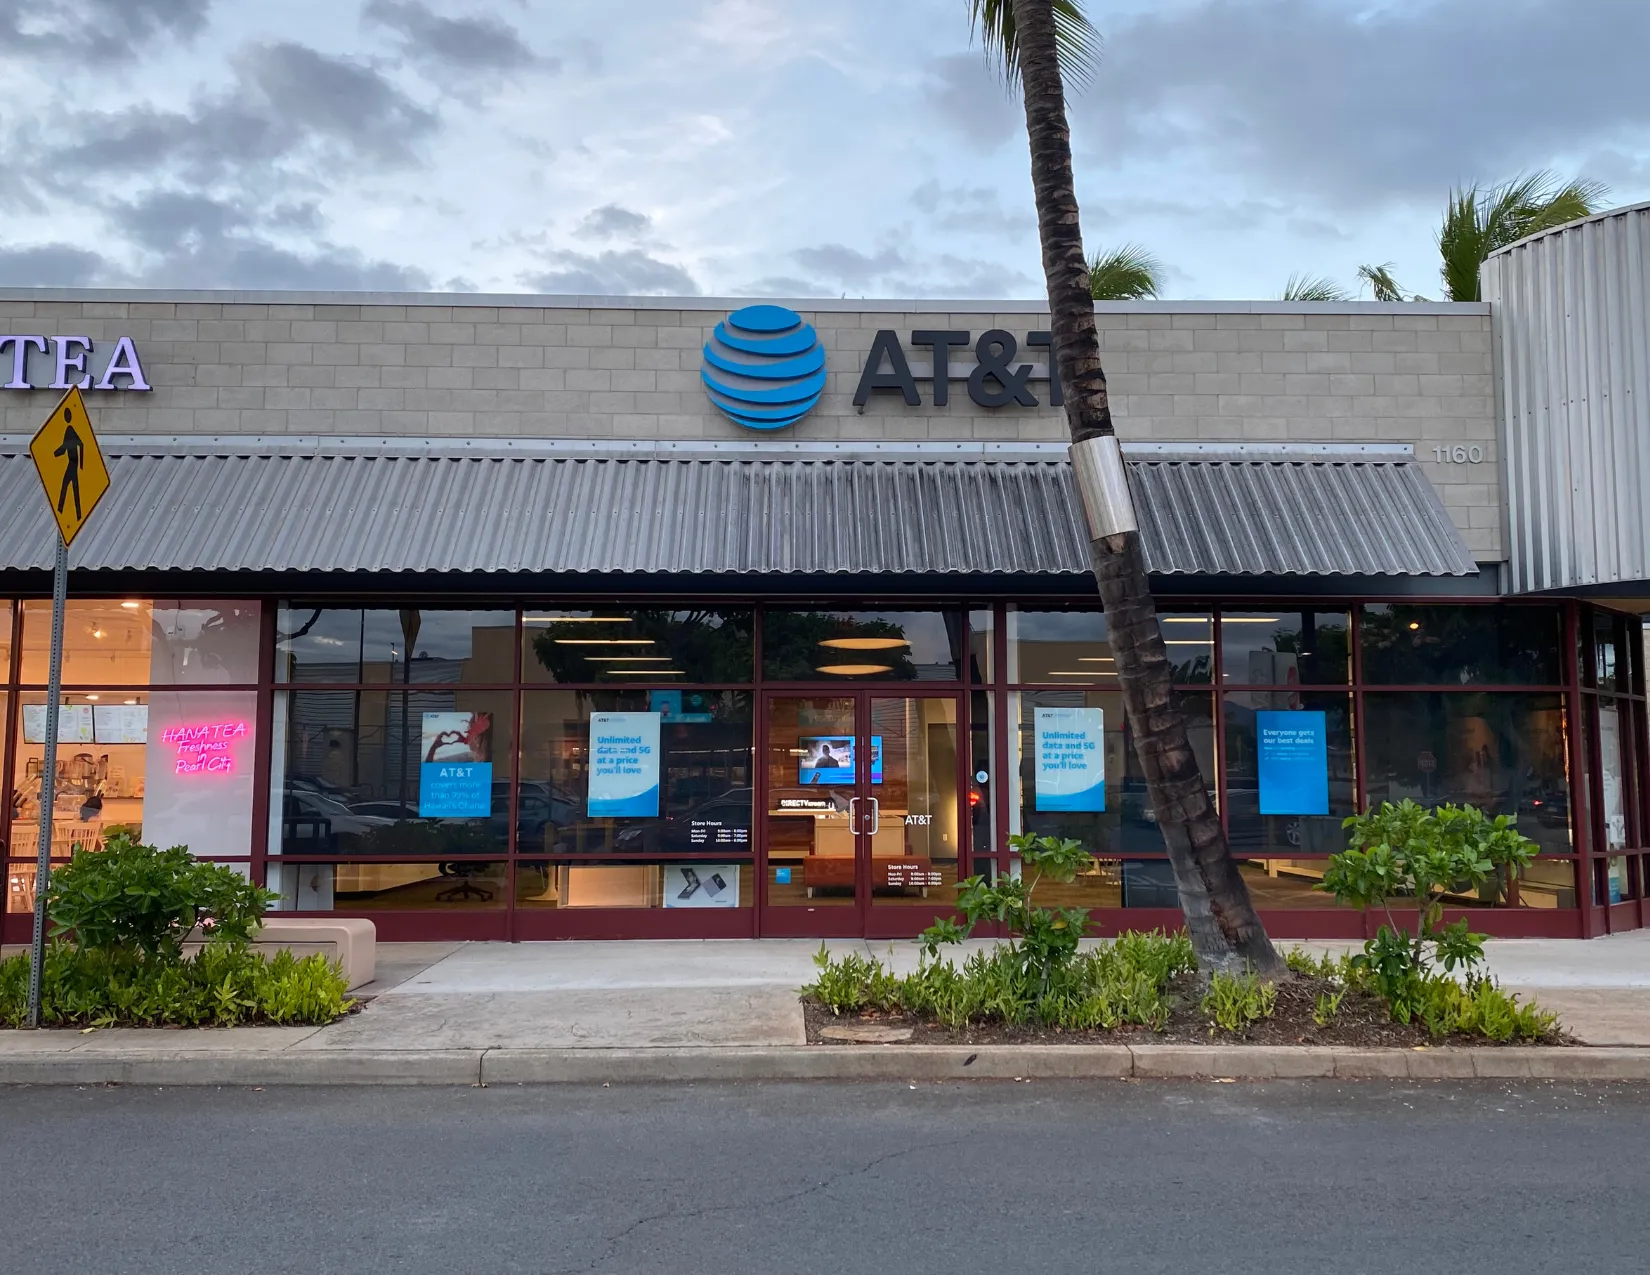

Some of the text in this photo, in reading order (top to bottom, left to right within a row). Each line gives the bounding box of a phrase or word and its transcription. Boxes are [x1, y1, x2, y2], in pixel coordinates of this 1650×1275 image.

[0, 335, 152, 391] TEA
[1432, 444, 1484, 464] 1160
[1042, 731, 1086, 740] Unlimited
[1263, 729, 1315, 737] Everyone gets
[597, 735, 642, 744] Unlimited
[177, 740, 228, 754] Freshness
[1042, 741, 1062, 749] data
[597, 746, 651, 754] data and 5G
[197, 753, 207, 762] in
[1062, 751, 1084, 761] price
[175, 756, 232, 774] Pearl City
[616, 756, 639, 766] price
[1068, 761, 1087, 769] love
[440, 767, 473, 777] AT&T
[623, 766, 642, 774] love
[431, 791, 450, 799] than
[471, 791, 481, 799] of
[905, 815, 933, 825] AT&T
